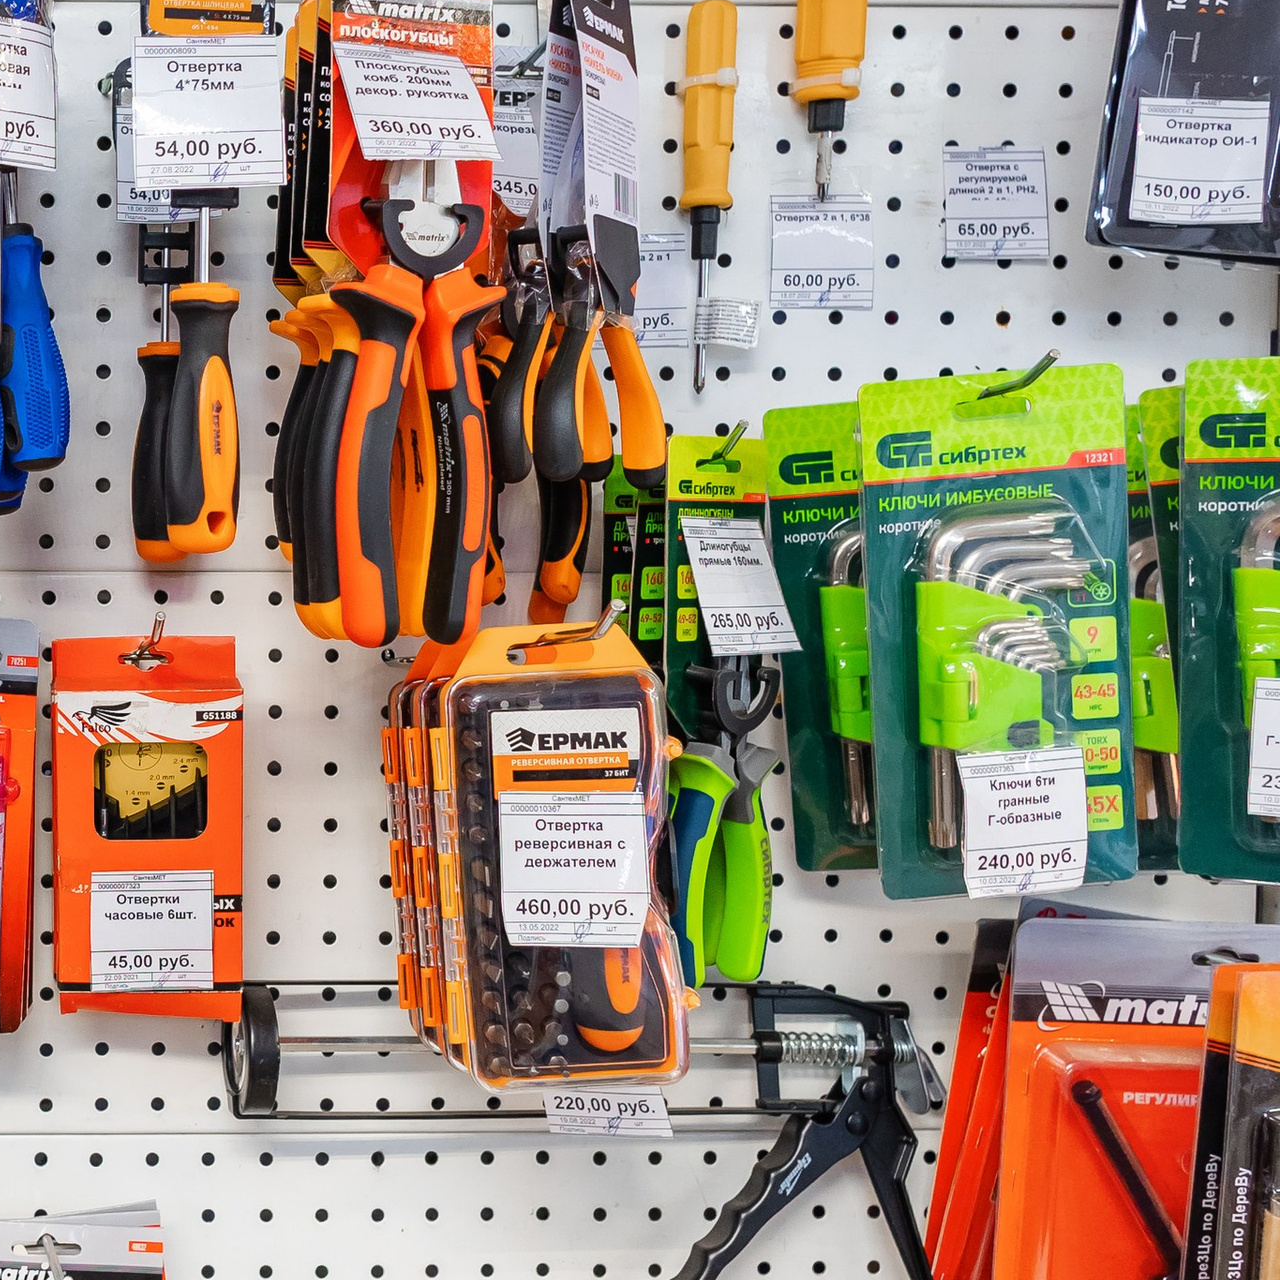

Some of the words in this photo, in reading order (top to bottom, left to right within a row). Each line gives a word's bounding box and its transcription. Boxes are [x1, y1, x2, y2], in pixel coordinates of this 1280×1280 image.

[377, 0, 456, 23] matrix
[339, 22, 454, 47] ПЛОСКОГУБЦЫ
[166, 60, 243, 74] Отвертка
[363, 73, 400, 87] комб.
[406, 75, 452, 88] 200мм
[5, 122, 40, 140] руб.
[368, 120, 433, 138] 360,00
[439, 122, 483, 141] руб.
[1166, 119, 1232, 133] Отвертка
[154, 140, 210, 158] 54,00
[217, 138, 262, 160] руб.
[1144, 134, 1217, 148] индикатор
[1144, 184, 1201, 202] 150,00
[1208, 185, 1251, 204] руб.
[784, 274, 822, 288] 60,00
[828, 275, 860, 290] руб.
[938, 443, 1026, 465] сибртех
[878, 492, 942, 512] КЛЮЧИ
[945, 482, 1053, 504] ИМБУСОВЫЕ
[710, 612, 750, 630] 265,00
[754, 611, 783, 629] руб.
[202, 710, 237, 721] 651188
[538, 731, 627, 751] ЕРМАК
[511, 755, 575, 767] РЕВЕРСИВНАЯ
[576, 756, 621, 766] ОТВЕРТКА
[535, 818, 604, 833] Отвертка
[515, 837, 615, 853] реверсивная
[978, 852, 1035, 873] 240,00
[1040, 851, 1077, 873] руб.
[116, 894, 180, 907] Отвертки
[516, 898, 581, 918] 460,00
[589, 898, 634, 920] руб.
[104, 910, 163, 922] часовые
[167, 910, 197, 921] 6шт.
[553, 1096, 611, 1114] 220,00
[618, 1097, 655, 1117] руб.
